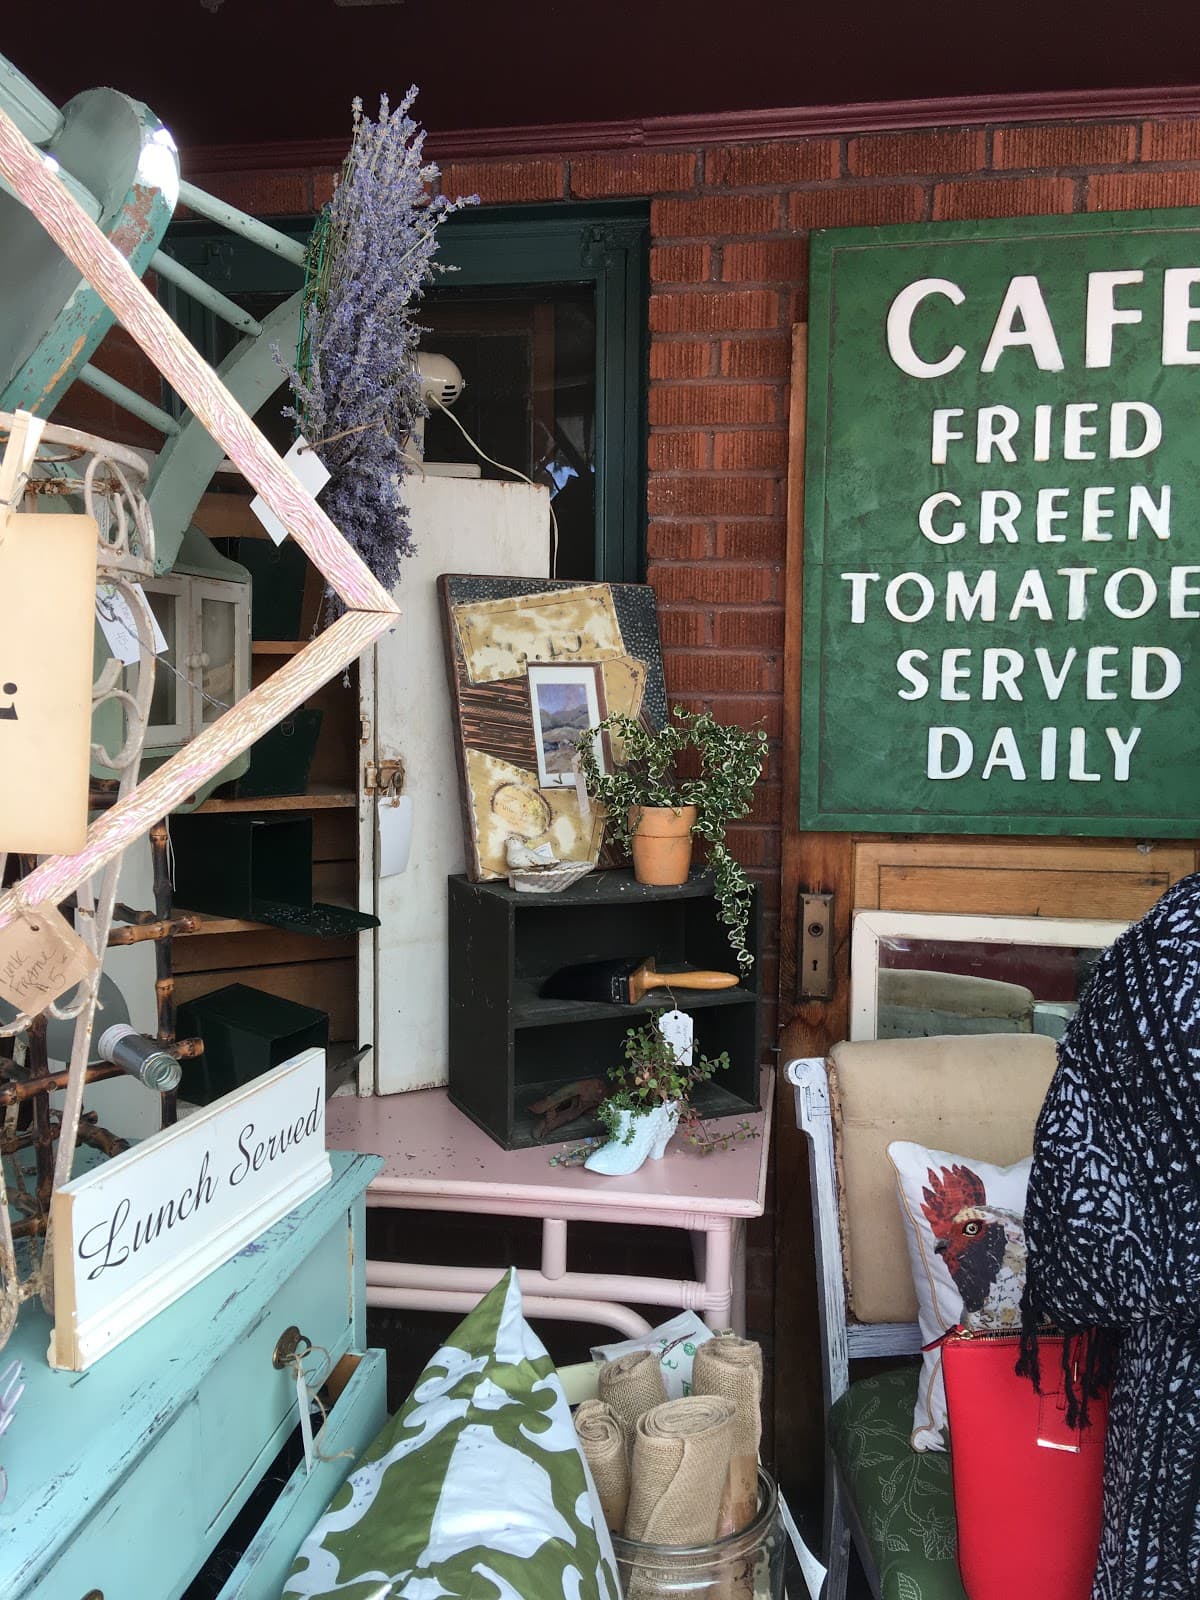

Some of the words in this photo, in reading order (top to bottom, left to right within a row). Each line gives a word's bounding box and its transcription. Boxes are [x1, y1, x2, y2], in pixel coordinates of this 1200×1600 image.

[887, 268, 1200, 378] CAFE
[931, 401, 1163, 464] FRIED
[918, 485, 1171, 545] GREEN
[840, 565, 1200, 624] TOMATOE
[896, 646, 1182, 701] SERVED
[927, 726, 1141, 781] DAILY
[78, 1150, 219, 1280] Lunch
[228, 1087, 323, 1186] Served
